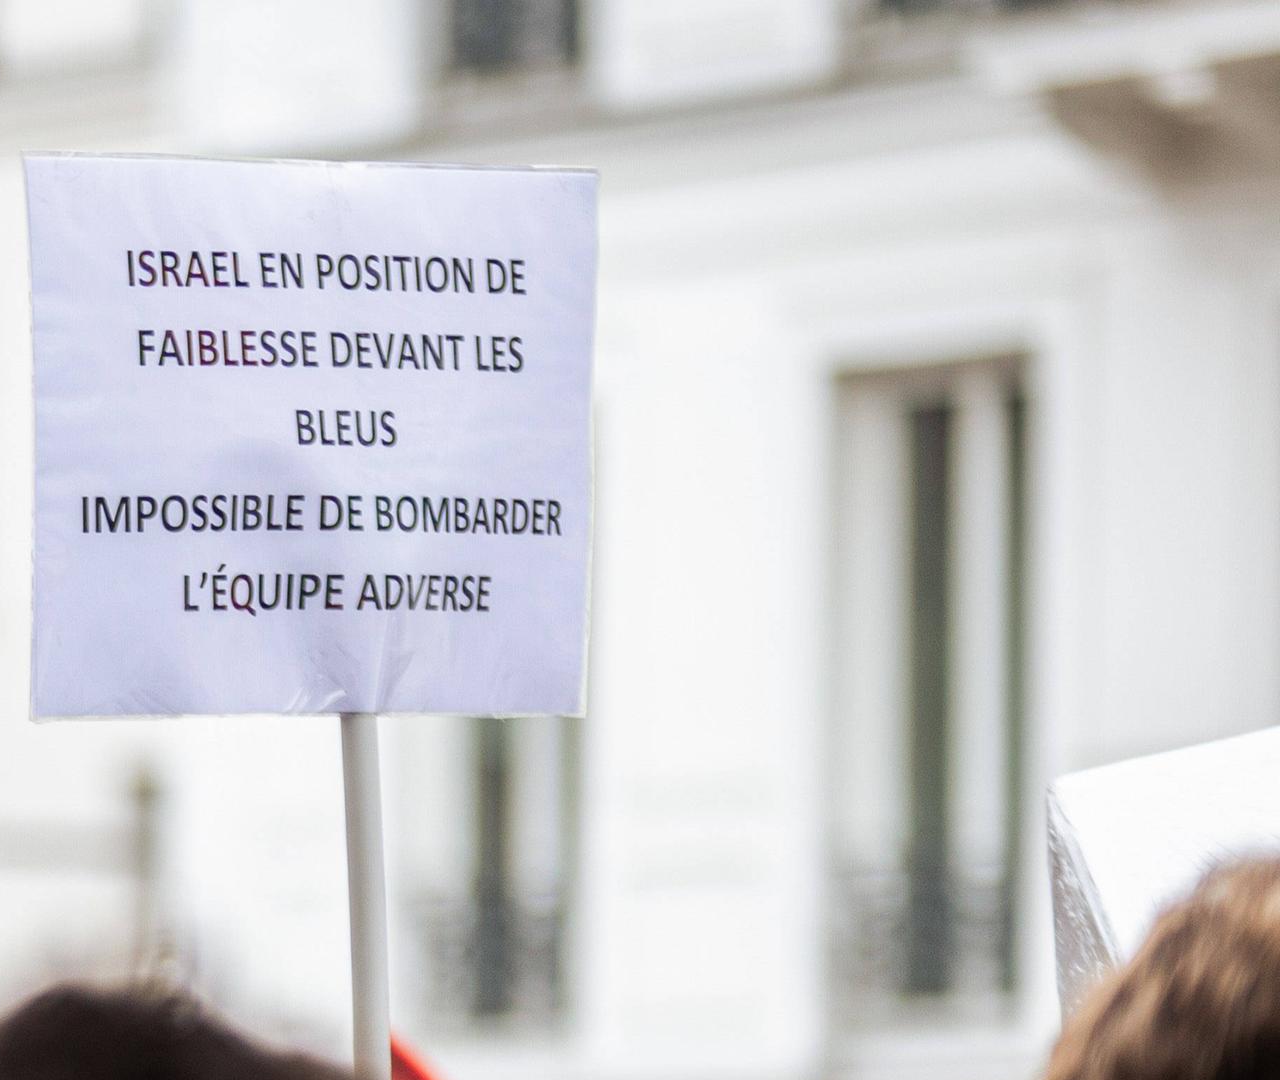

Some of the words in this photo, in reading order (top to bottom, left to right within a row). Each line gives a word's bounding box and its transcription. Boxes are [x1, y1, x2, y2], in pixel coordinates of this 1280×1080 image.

[126, 250, 251, 289] ISRAEL
[259, 252, 305, 290] EN
[315, 253, 476, 294] POSITION
[485, 258, 527, 296] DE
[138, 329, 320, 368] FAIBLESSE
[329, 331, 465, 372] DEVANT
[474, 335, 525, 373] LES
[295, 409, 398, 448] BLEUS
[81, 494, 307, 534] IMPOSSIBLE
[318, 494, 365, 533] DE
[374, 495, 563, 537] BOMBARDER
[182, 564, 346, 618] L’ÉQUIPE
[356, 573, 493, 614] ADVERSE
